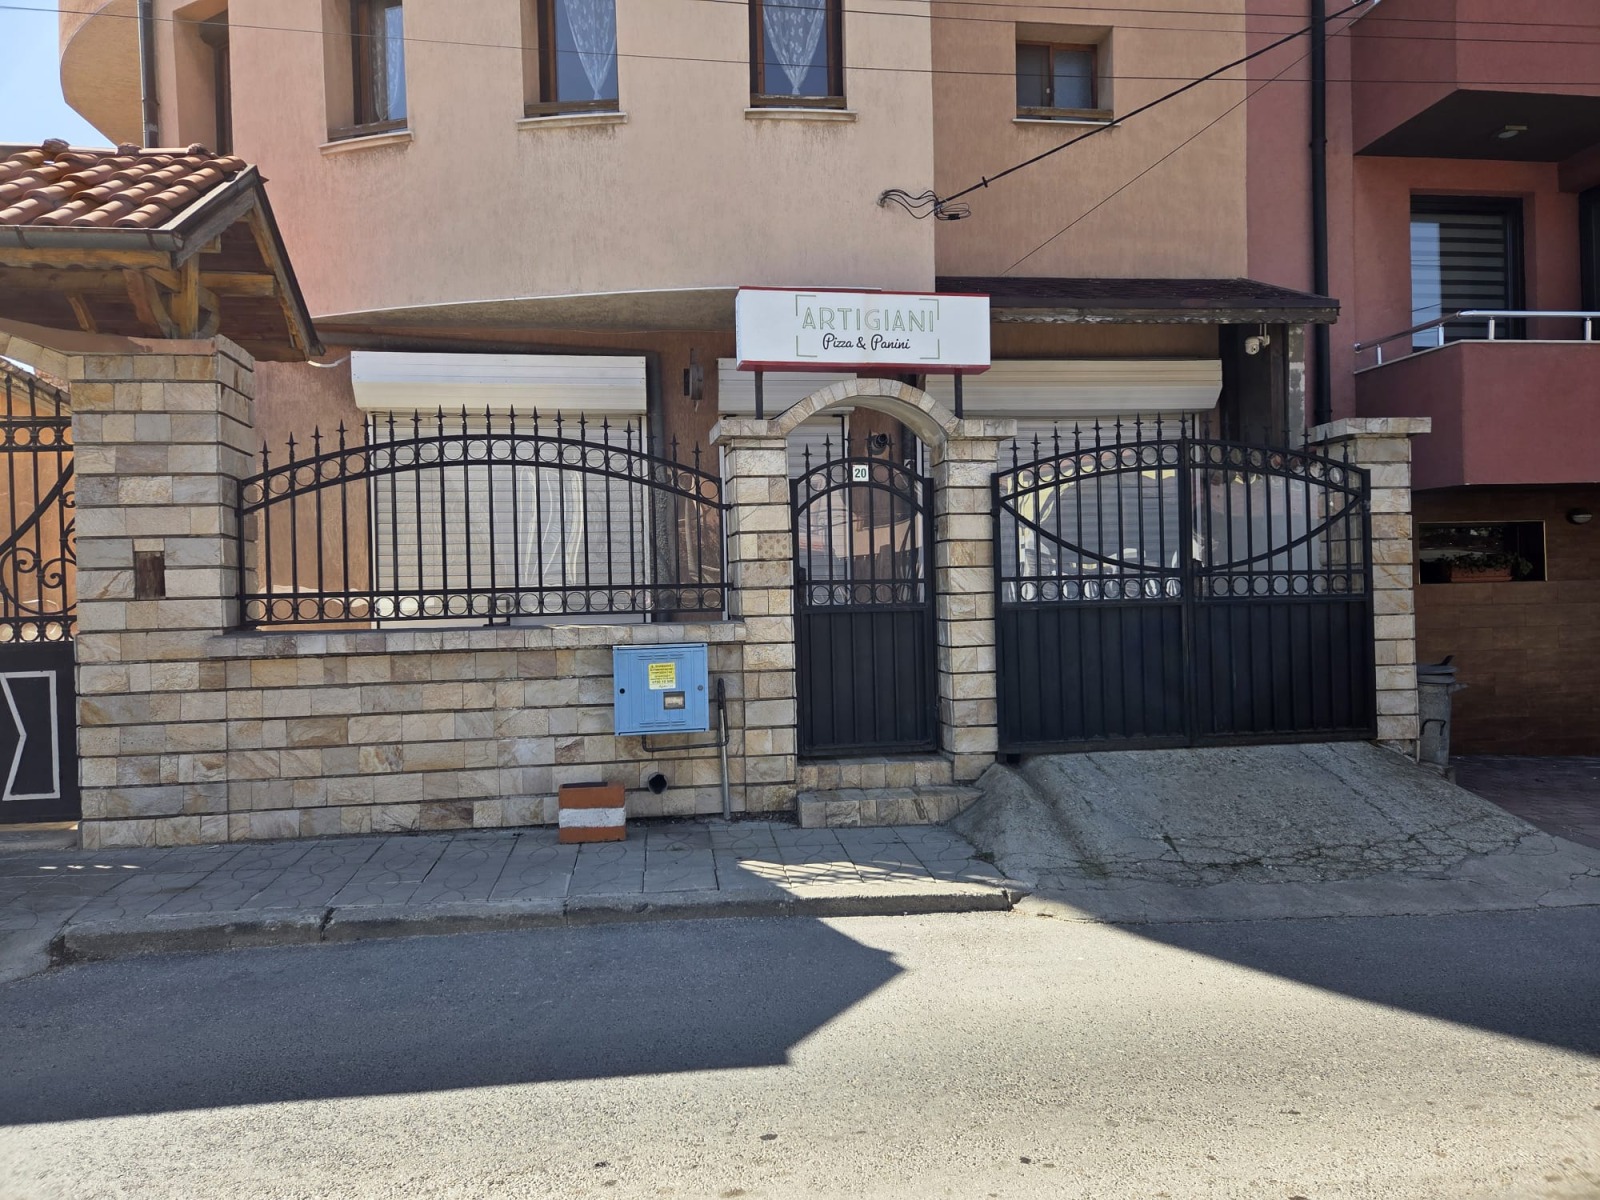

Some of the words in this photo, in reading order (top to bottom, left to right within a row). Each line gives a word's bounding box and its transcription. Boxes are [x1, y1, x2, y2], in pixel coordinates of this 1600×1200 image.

[802, 307, 934, 332] ARTIGIANI
[822, 332, 854, 350] Pizza
[856, 336, 867, 350] &
[870, 333, 911, 351] Panini
[854, 468, 867, 478] 20
